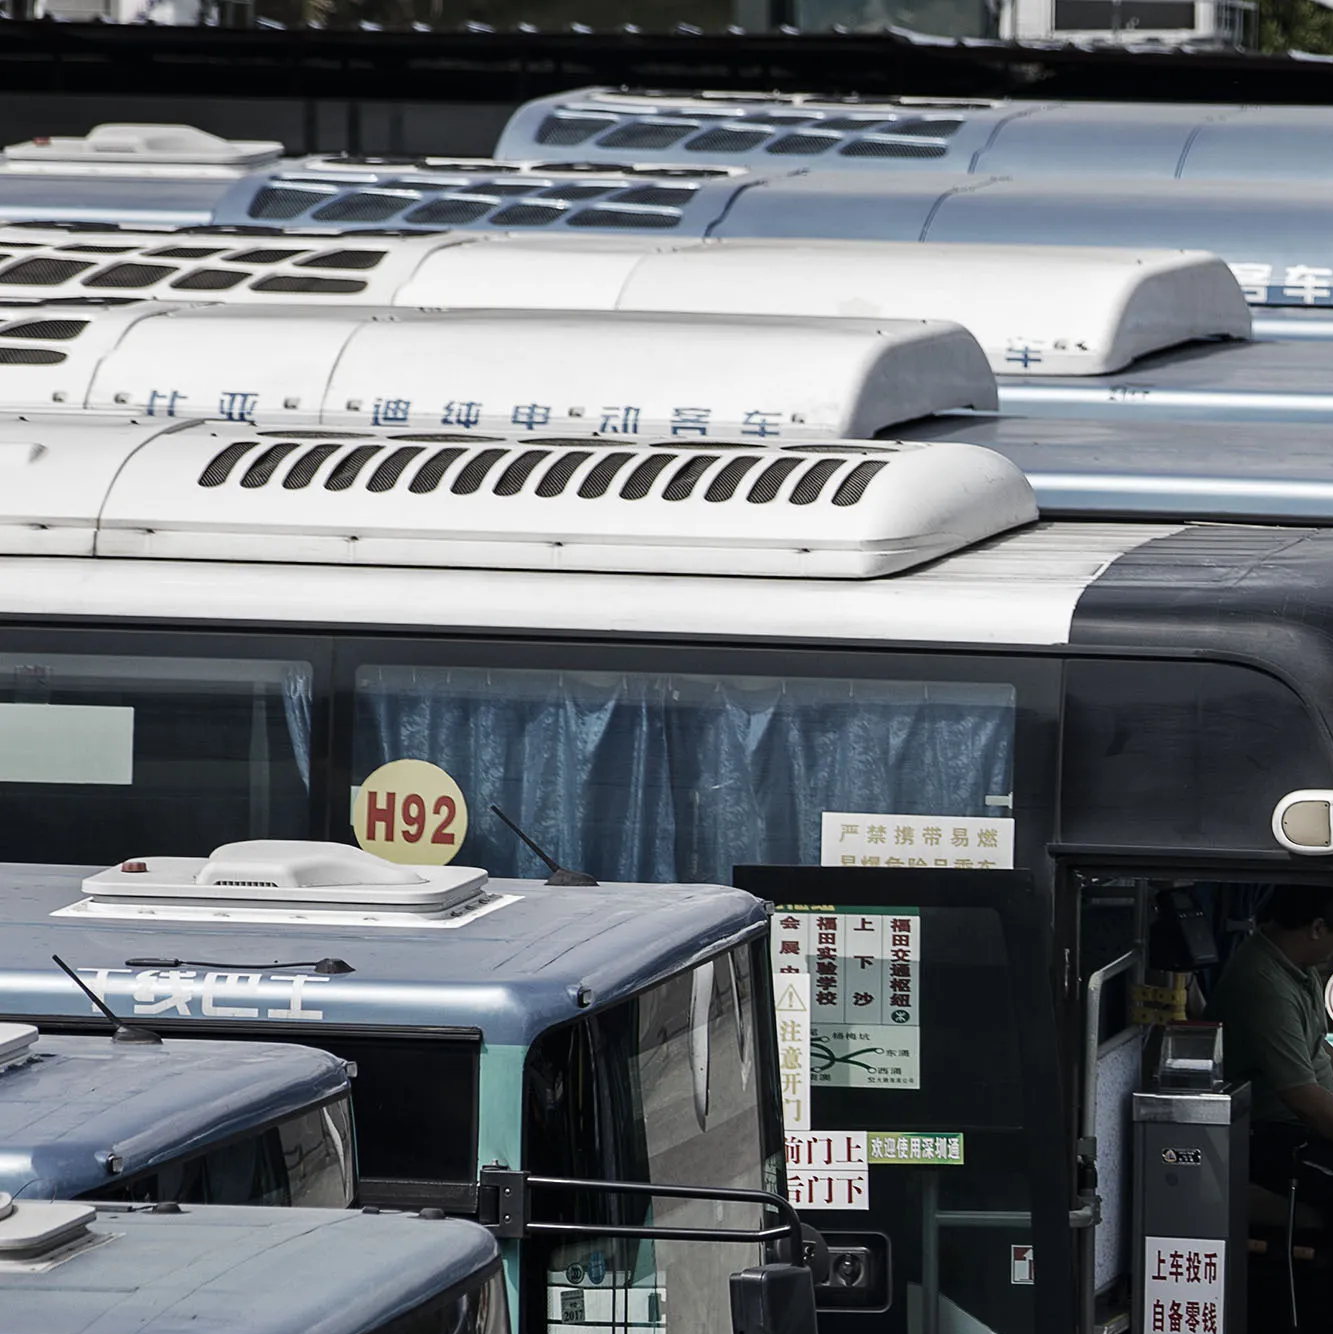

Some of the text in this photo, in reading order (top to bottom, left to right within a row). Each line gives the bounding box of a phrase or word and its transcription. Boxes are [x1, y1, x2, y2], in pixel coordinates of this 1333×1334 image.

[366, 791, 456, 845] H92
[839, 824, 999, 848] 严禁携带易燃
[853, 918, 875, 1007] 上下沙
[779, 1020, 802, 1122] 注意开门
[871, 1136, 961, 1160] 欢迎使用深圳通
[1151, 1250, 1218, 1285] 上车投币
[563, 1310, 584, 1322] 2017
